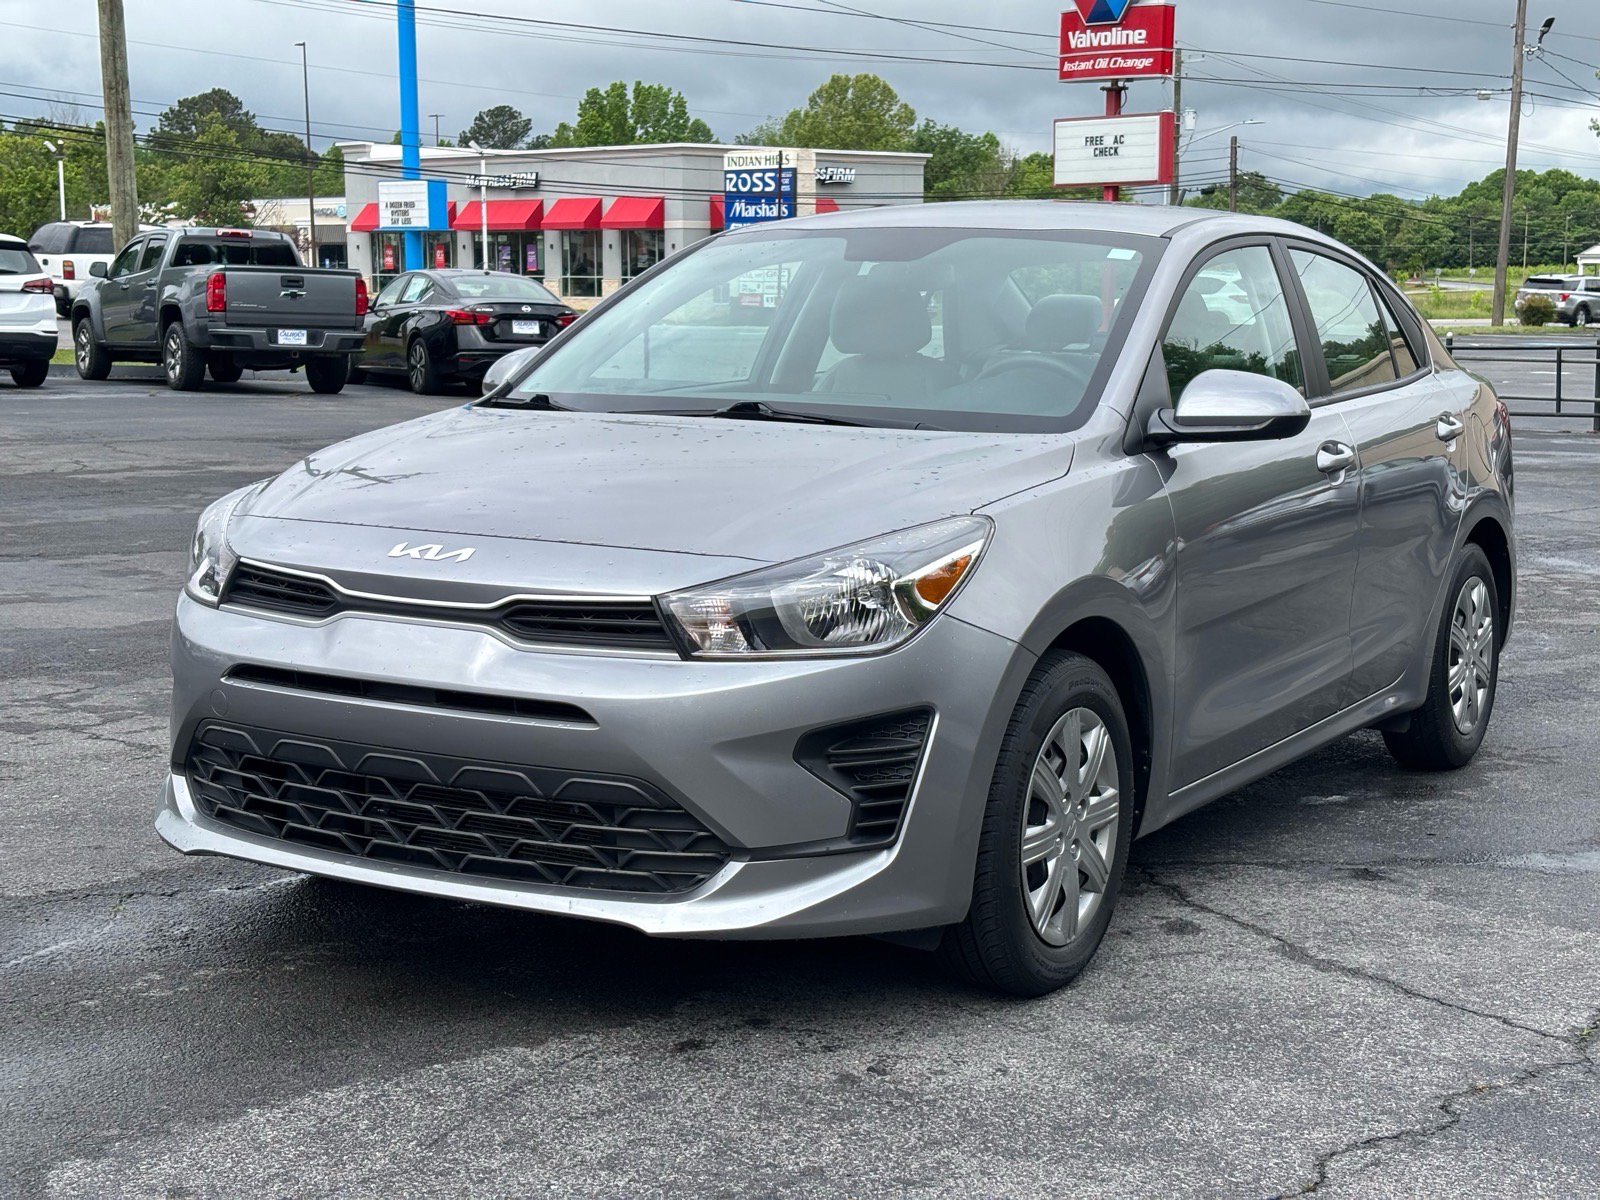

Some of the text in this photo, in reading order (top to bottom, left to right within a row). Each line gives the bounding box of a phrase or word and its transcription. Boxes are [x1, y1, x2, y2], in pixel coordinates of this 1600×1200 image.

[1068, 27, 1147, 48] Valvoline
[1063, 57, 1154, 71] Instant Oil Change
[1085, 135, 1125, 146] FREE AC
[1093, 146, 1119, 157] CHECK
[727, 155, 761, 167] INDIAN
[726, 172, 776, 192] ROSS
[391, 209, 410, 217] OYSTERS
[729, 199, 789, 217] Marshalls
[401, 217, 412, 225] LESS
[387, 542, 477, 563] KIA
